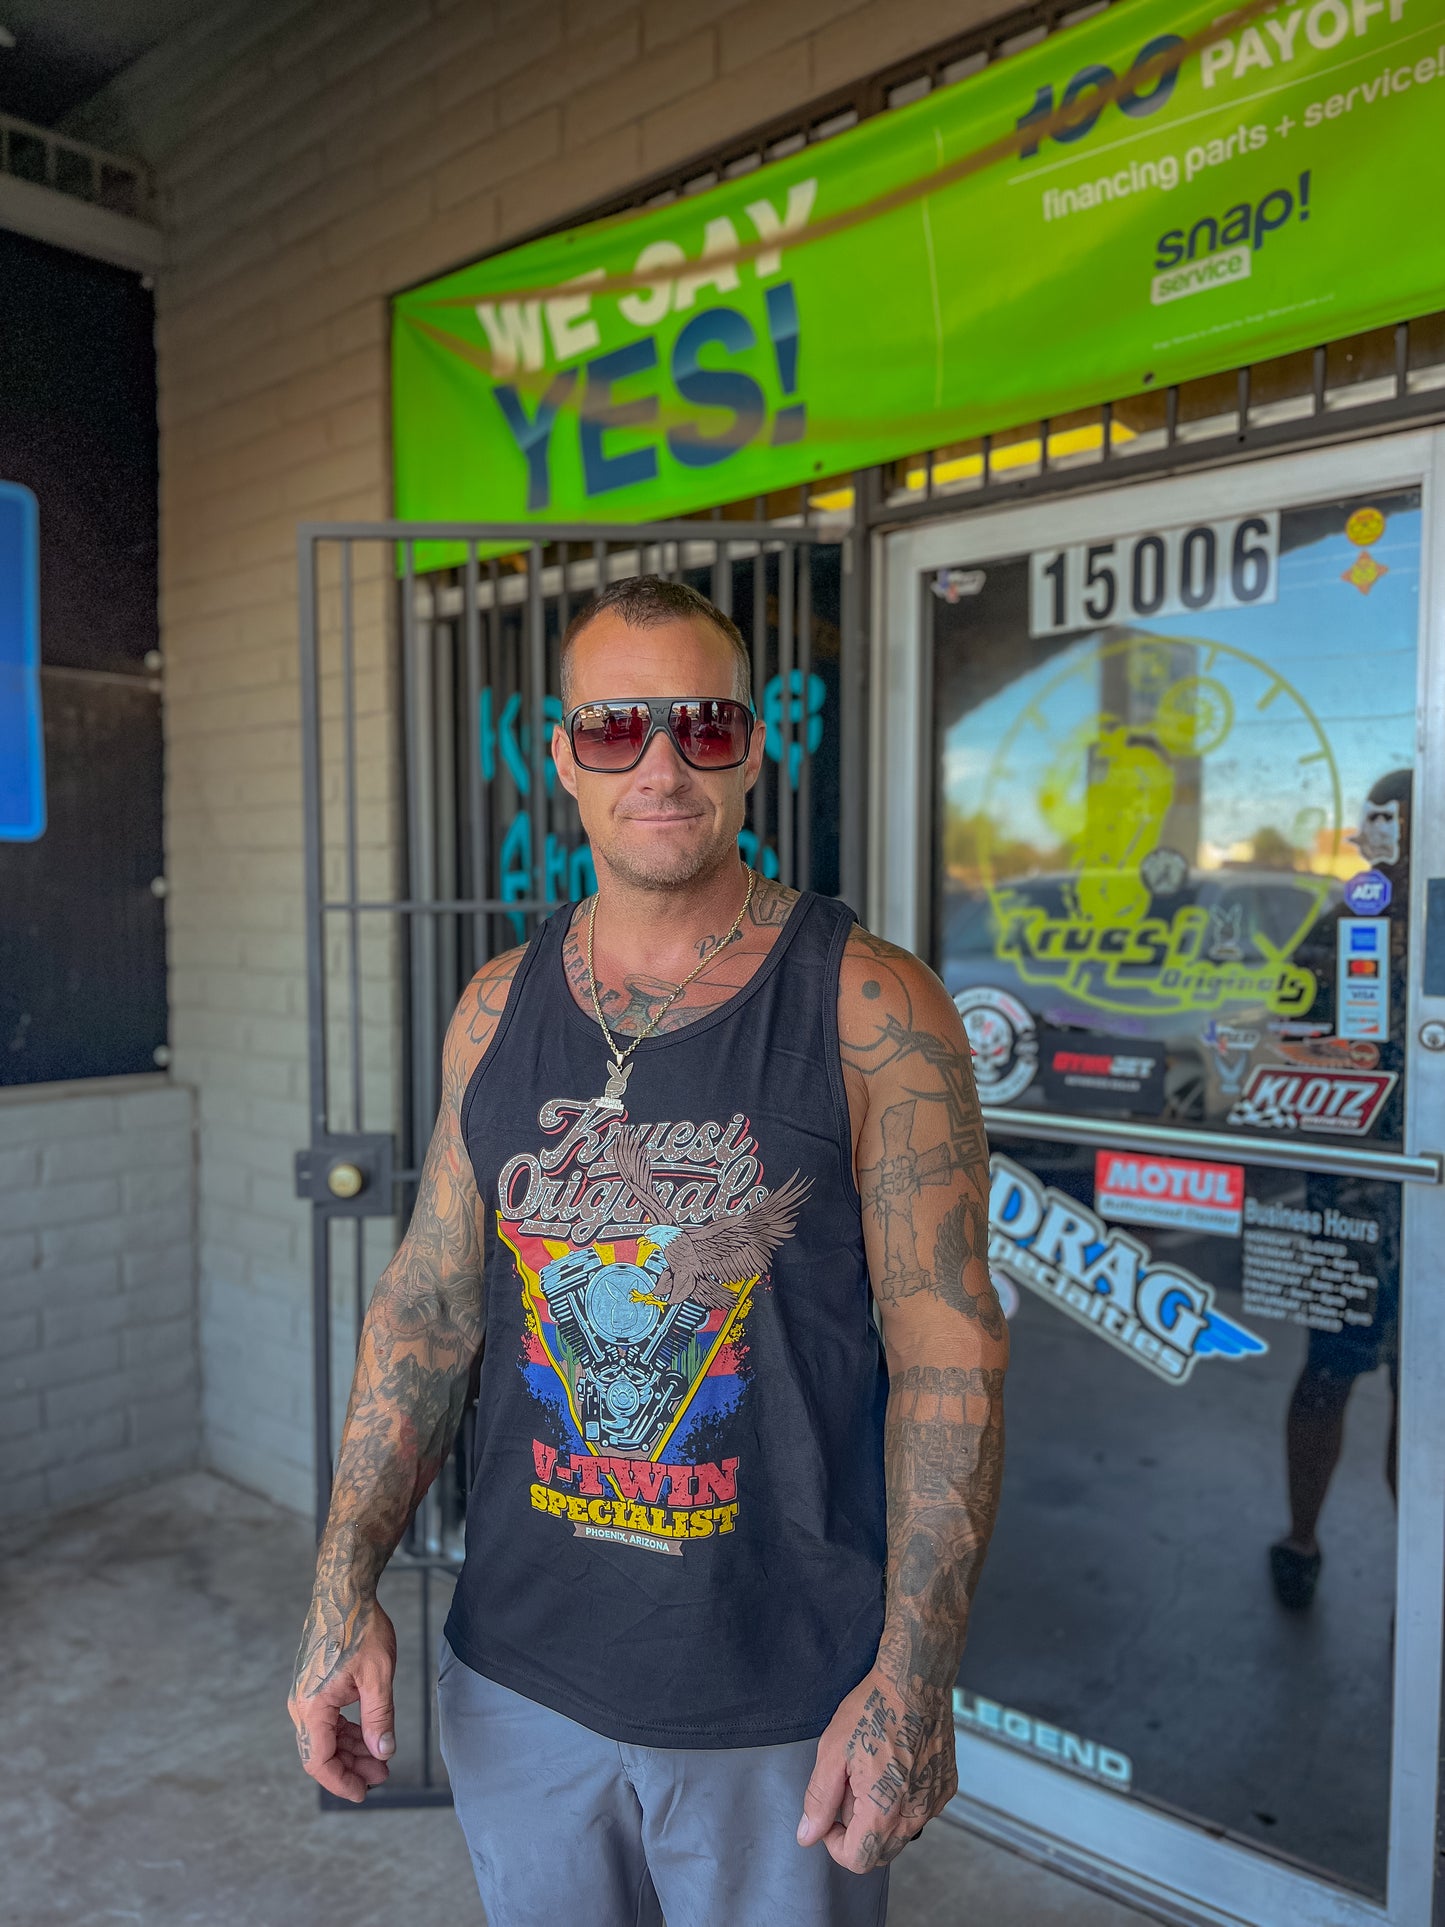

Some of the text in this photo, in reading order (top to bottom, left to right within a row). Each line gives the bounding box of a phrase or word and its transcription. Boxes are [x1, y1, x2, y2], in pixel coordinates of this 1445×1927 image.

[1016, 34, 1189, 160] 100
[1042, 154, 1179, 222] financing
[1185, 123, 1268, 182] parts
[1154, 169, 1311, 271] snap!
[475, 178, 818, 378] WE SAY
[1158, 252, 1243, 298] service
[492, 280, 808, 514] YES!
[1042, 518, 1269, 626] 15006
[1351, 882, 1384, 901] ADT
[1252, 1073, 1380, 1118] KLOTZ
[1106, 1159, 1235, 1204] MOTUL
[1243, 1195, 1323, 1236] Business
[1322, 1206, 1380, 1245] Hours
[989, 1165, 1207, 1355] DRAG
[988, 1235, 1187, 1376] pecialties
[529, 1483, 740, 1540] SPECIALIST
[531, 1438, 740, 1509] V-TWIN
[585, 1526, 670, 1552] PHOENIX, ARIZONA
[952, 1686, 1134, 1783] LEGEND
[867, 1756, 910, 1817] FORGET
